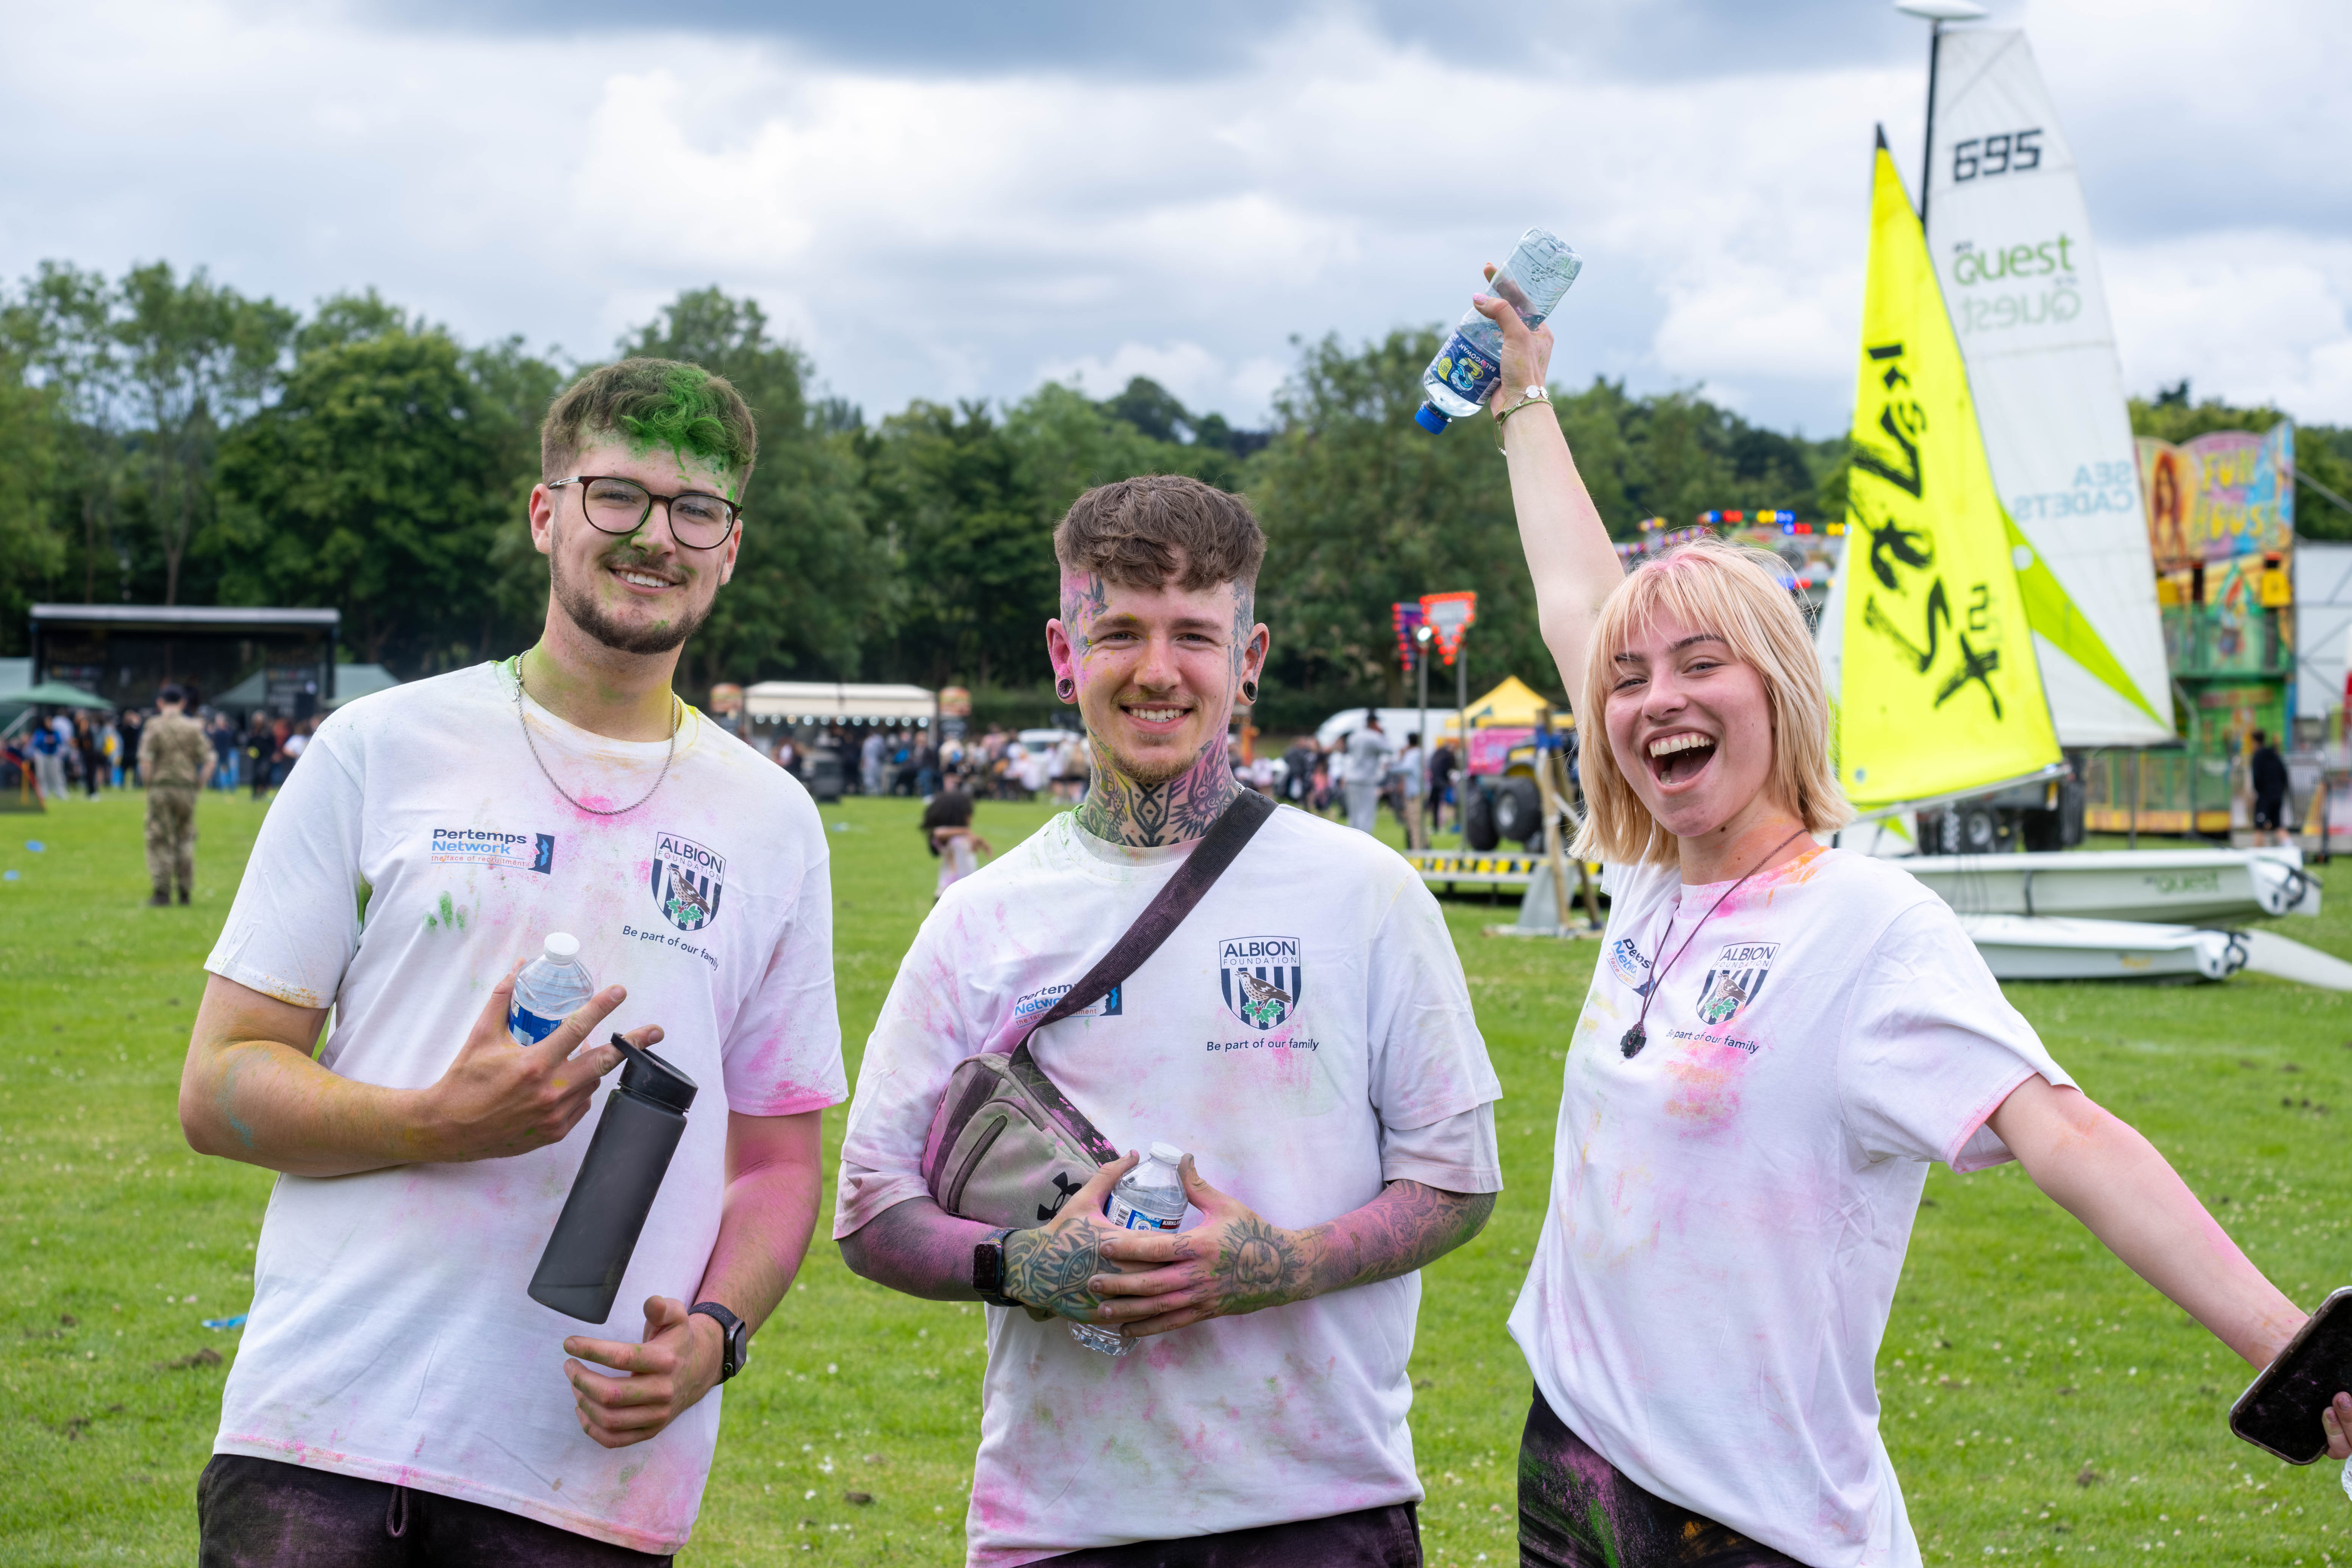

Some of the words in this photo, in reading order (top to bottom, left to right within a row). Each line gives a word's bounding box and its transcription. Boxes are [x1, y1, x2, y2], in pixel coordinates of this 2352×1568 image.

[1954, 128, 2042, 182] 695
[1953, 233, 2075, 286] Quest
[1458, 343, 1496, 372] BALYGOWAN
[433, 829, 527, 844] Pertemps
[431, 841, 510, 854] Network
[659, 837, 722, 874] ALBION
[478, 856, 525, 867] recruitment
[658, 850, 721, 881] FOUNDATION
[622, 925, 638, 936] Be
[640, 932, 665, 943] part
[667, 938, 680, 947] of
[681, 943, 699, 954] our
[700, 948, 719, 971] family
[1224, 941, 1296, 958] ALBION
[1719, 946, 1776, 961] ALBION
[1223, 957, 1297, 966] FOUNDATION
[1610, 957, 1619, 972] face
[1714, 960, 1769, 968] FOUNDATION
[1016, 983, 1077, 1005] Pertem
[1030, 1012, 1046, 1022] face
[1206, 1041, 1221, 1051] Be
[1225, 1040, 1249, 1052] part
[1252, 1038, 1264, 1048] of
[1289, 1038, 1319, 1051] family
[1672, 1030, 1693, 1040] part
[1694, 1032, 1707, 1041] of
[1705, 1035, 1722, 1044] our
[1724, 1035, 1760, 1054] family
